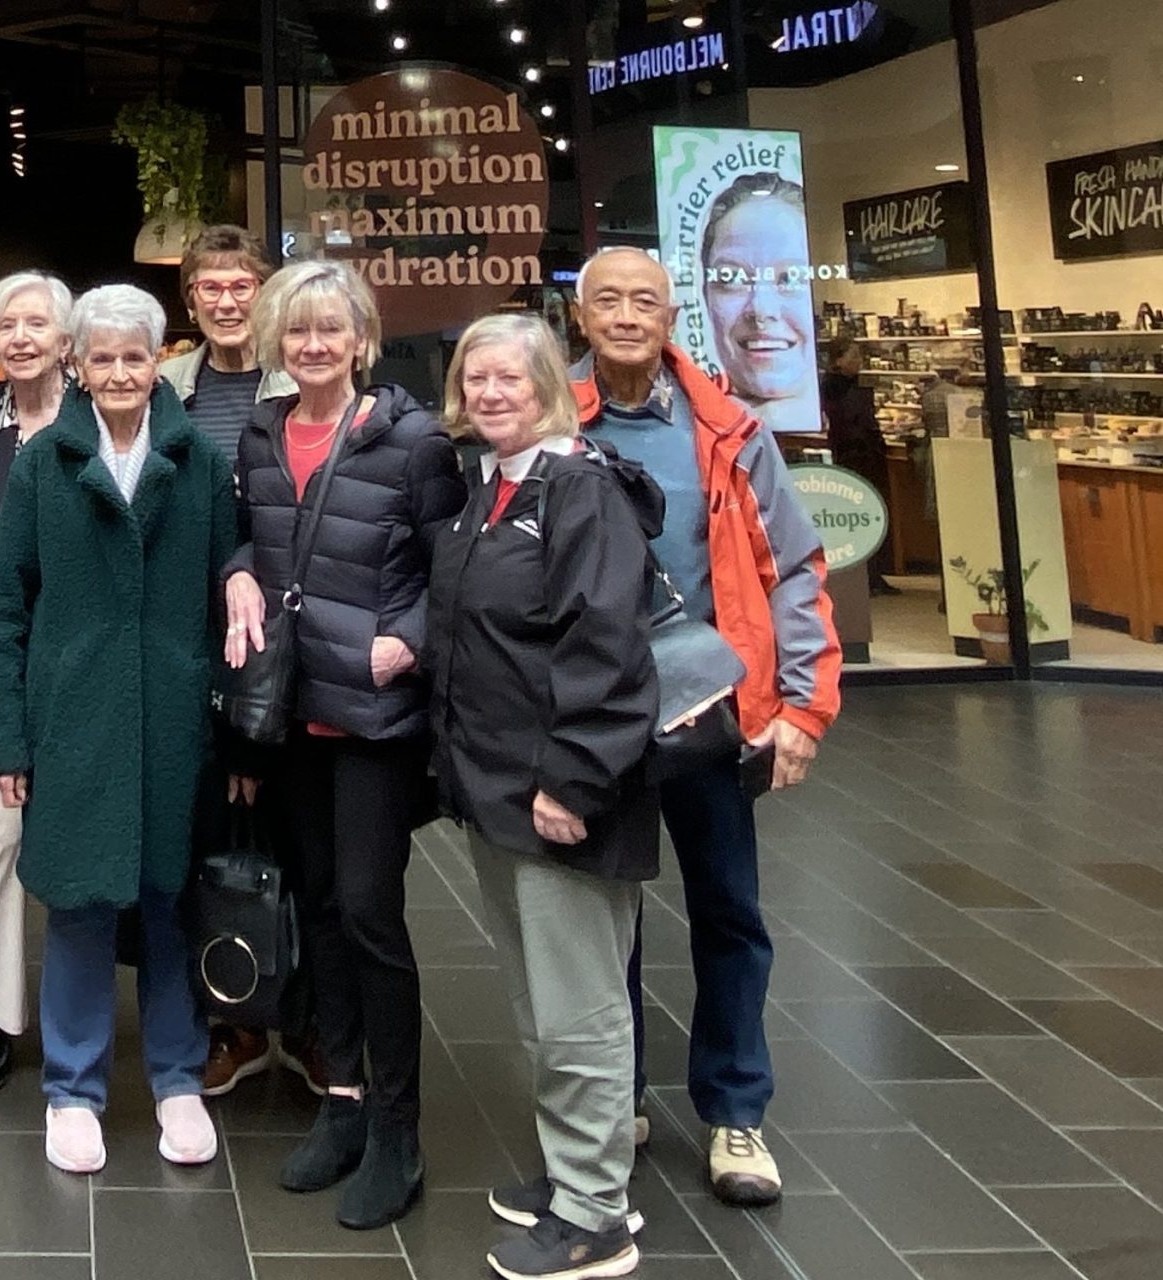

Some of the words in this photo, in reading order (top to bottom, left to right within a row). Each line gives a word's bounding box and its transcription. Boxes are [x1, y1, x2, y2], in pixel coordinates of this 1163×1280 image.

[332, 92, 521, 141] minimal
[303, 144, 544, 196] disruption
[1074, 165, 1116, 195] FRESH
[1124, 156, 1163, 182] HAND
[310, 197, 546, 238] maximum
[674, 177, 713, 287] barrier
[712, 141, 785, 181] relief
[1069, 184, 1163, 239] SKINCA
[318, 245, 543, 286] ydration
[794, 474, 864, 504] obiome
[812, 508, 870, 532] shops
